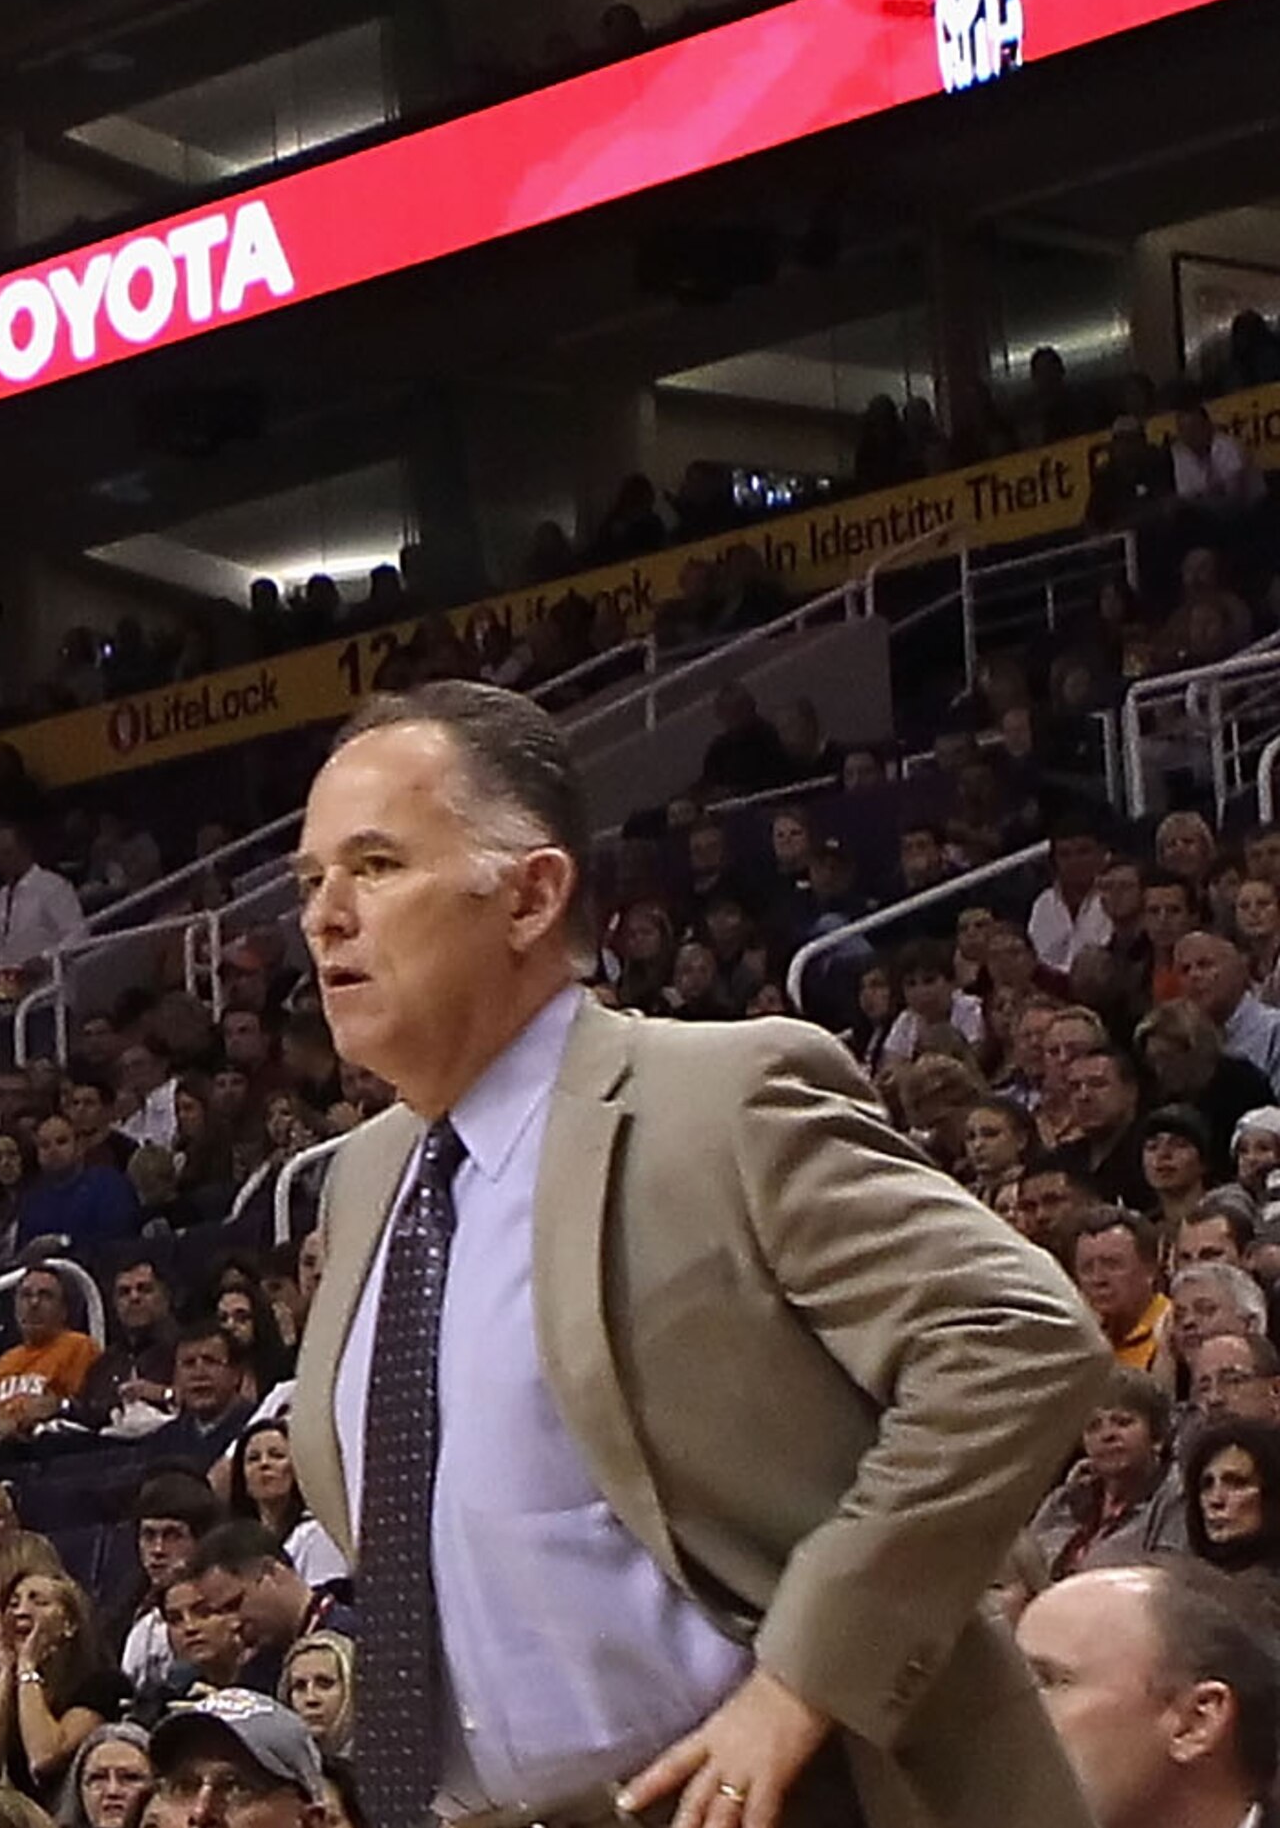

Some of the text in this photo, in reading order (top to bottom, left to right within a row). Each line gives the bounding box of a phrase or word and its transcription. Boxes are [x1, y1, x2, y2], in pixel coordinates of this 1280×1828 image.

[808, 495, 957, 564] Identity
[966, 461, 1077, 524] Theft
[144, 668, 281, 743] LifeLock
